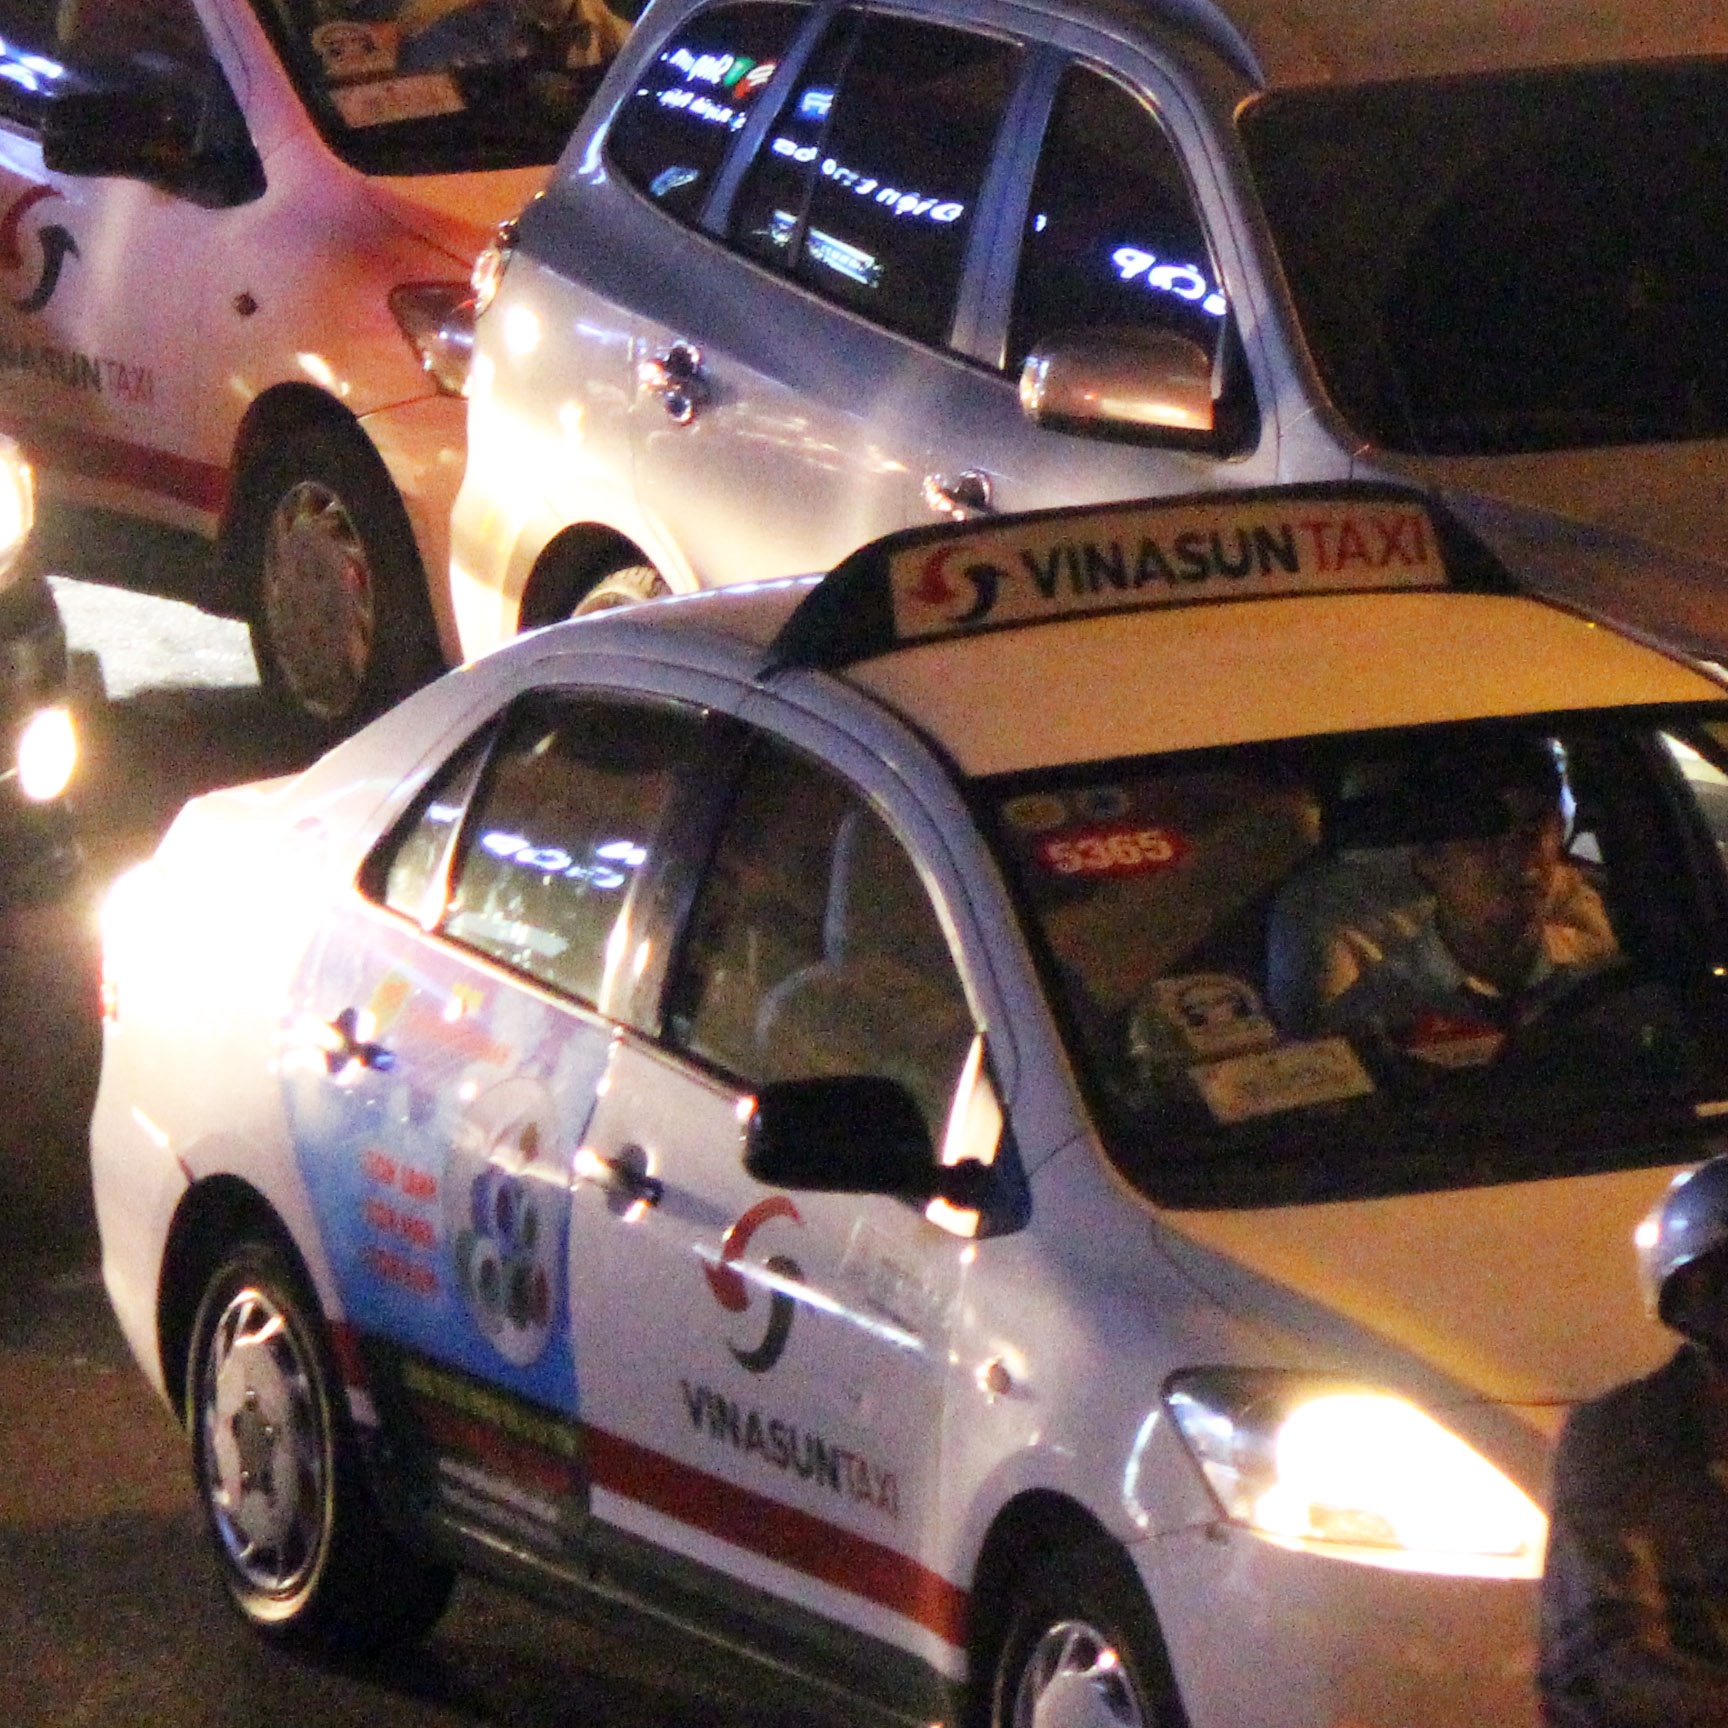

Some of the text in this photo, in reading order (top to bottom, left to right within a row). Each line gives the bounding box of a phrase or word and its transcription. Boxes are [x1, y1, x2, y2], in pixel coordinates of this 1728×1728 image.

[1020, 514, 1430, 600] VINASUN TAXI
[1045, 829, 1175, 874] 5365
[681, 1378, 842, 1494] VINASUN
